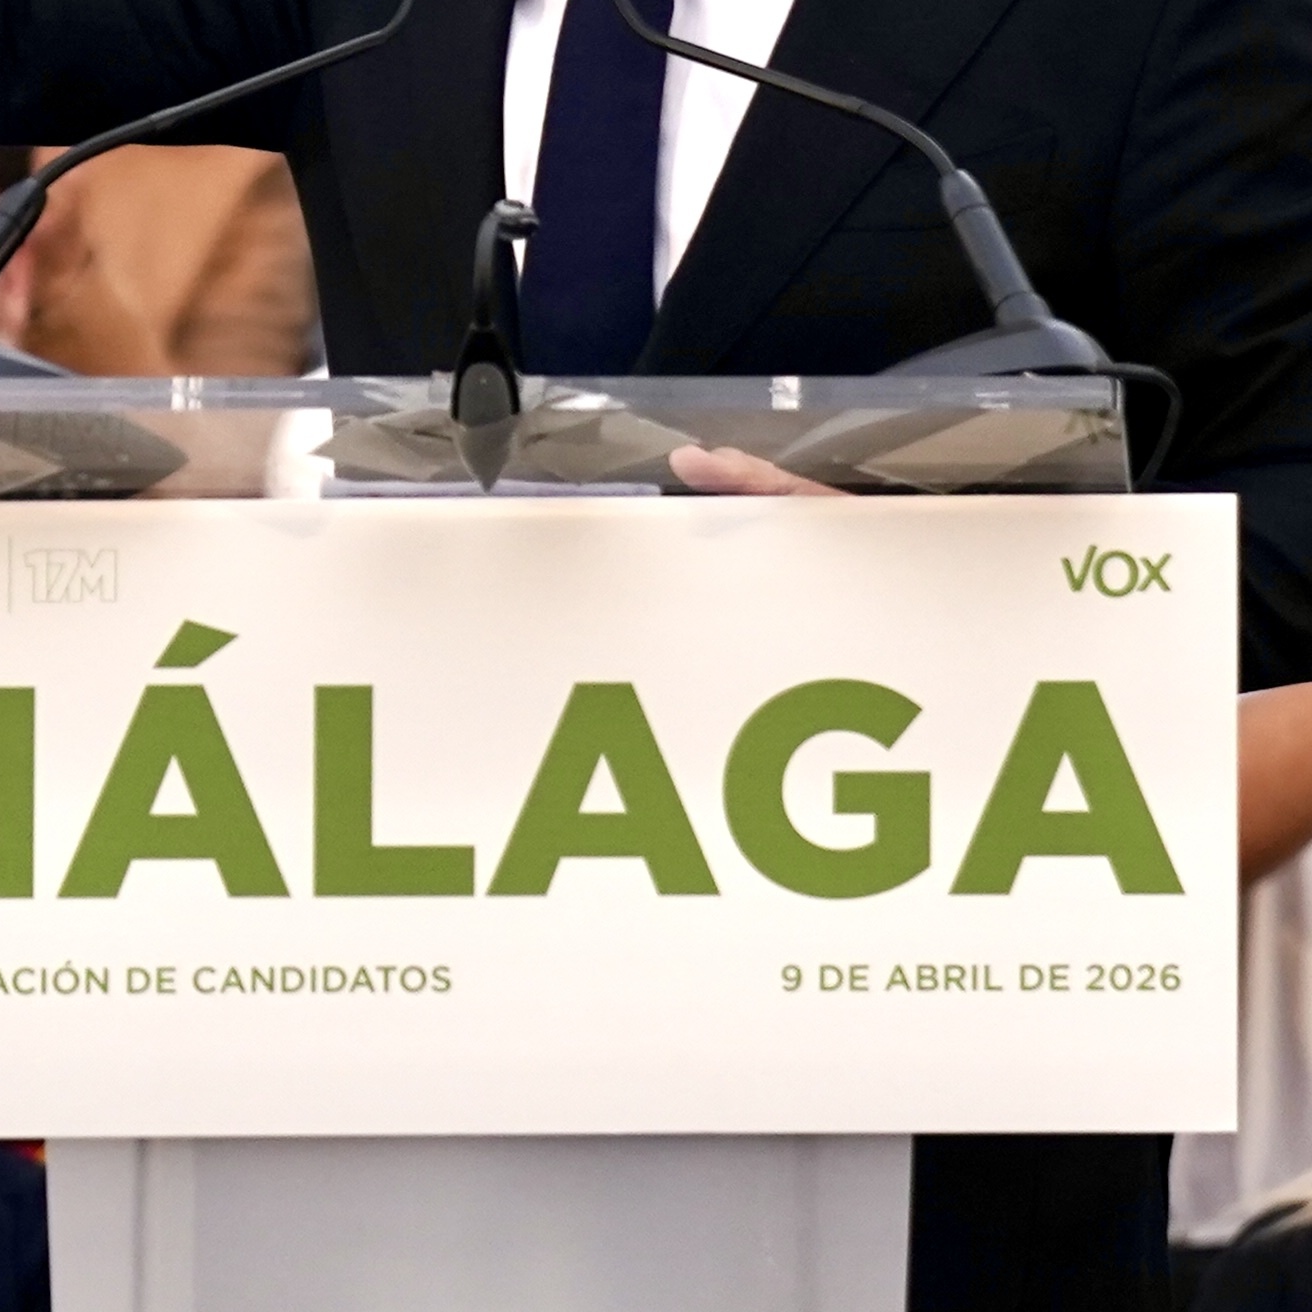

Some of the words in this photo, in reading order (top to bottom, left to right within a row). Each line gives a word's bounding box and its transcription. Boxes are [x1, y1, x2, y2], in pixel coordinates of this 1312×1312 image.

[24, 548, 118, 604] 17M
[1060, 544, 1172, 598] VOX
[126, 966, 176, 995] DE
[192, 965, 453, 996] CANDIDATOS
[781, 964, 803, 993] 9
[819, 964, 870, 992] DE
[885, 963, 1003, 992] ABRIL
[1019, 963, 1070, 992] DE
[1085, 963, 1183, 992] 2026
